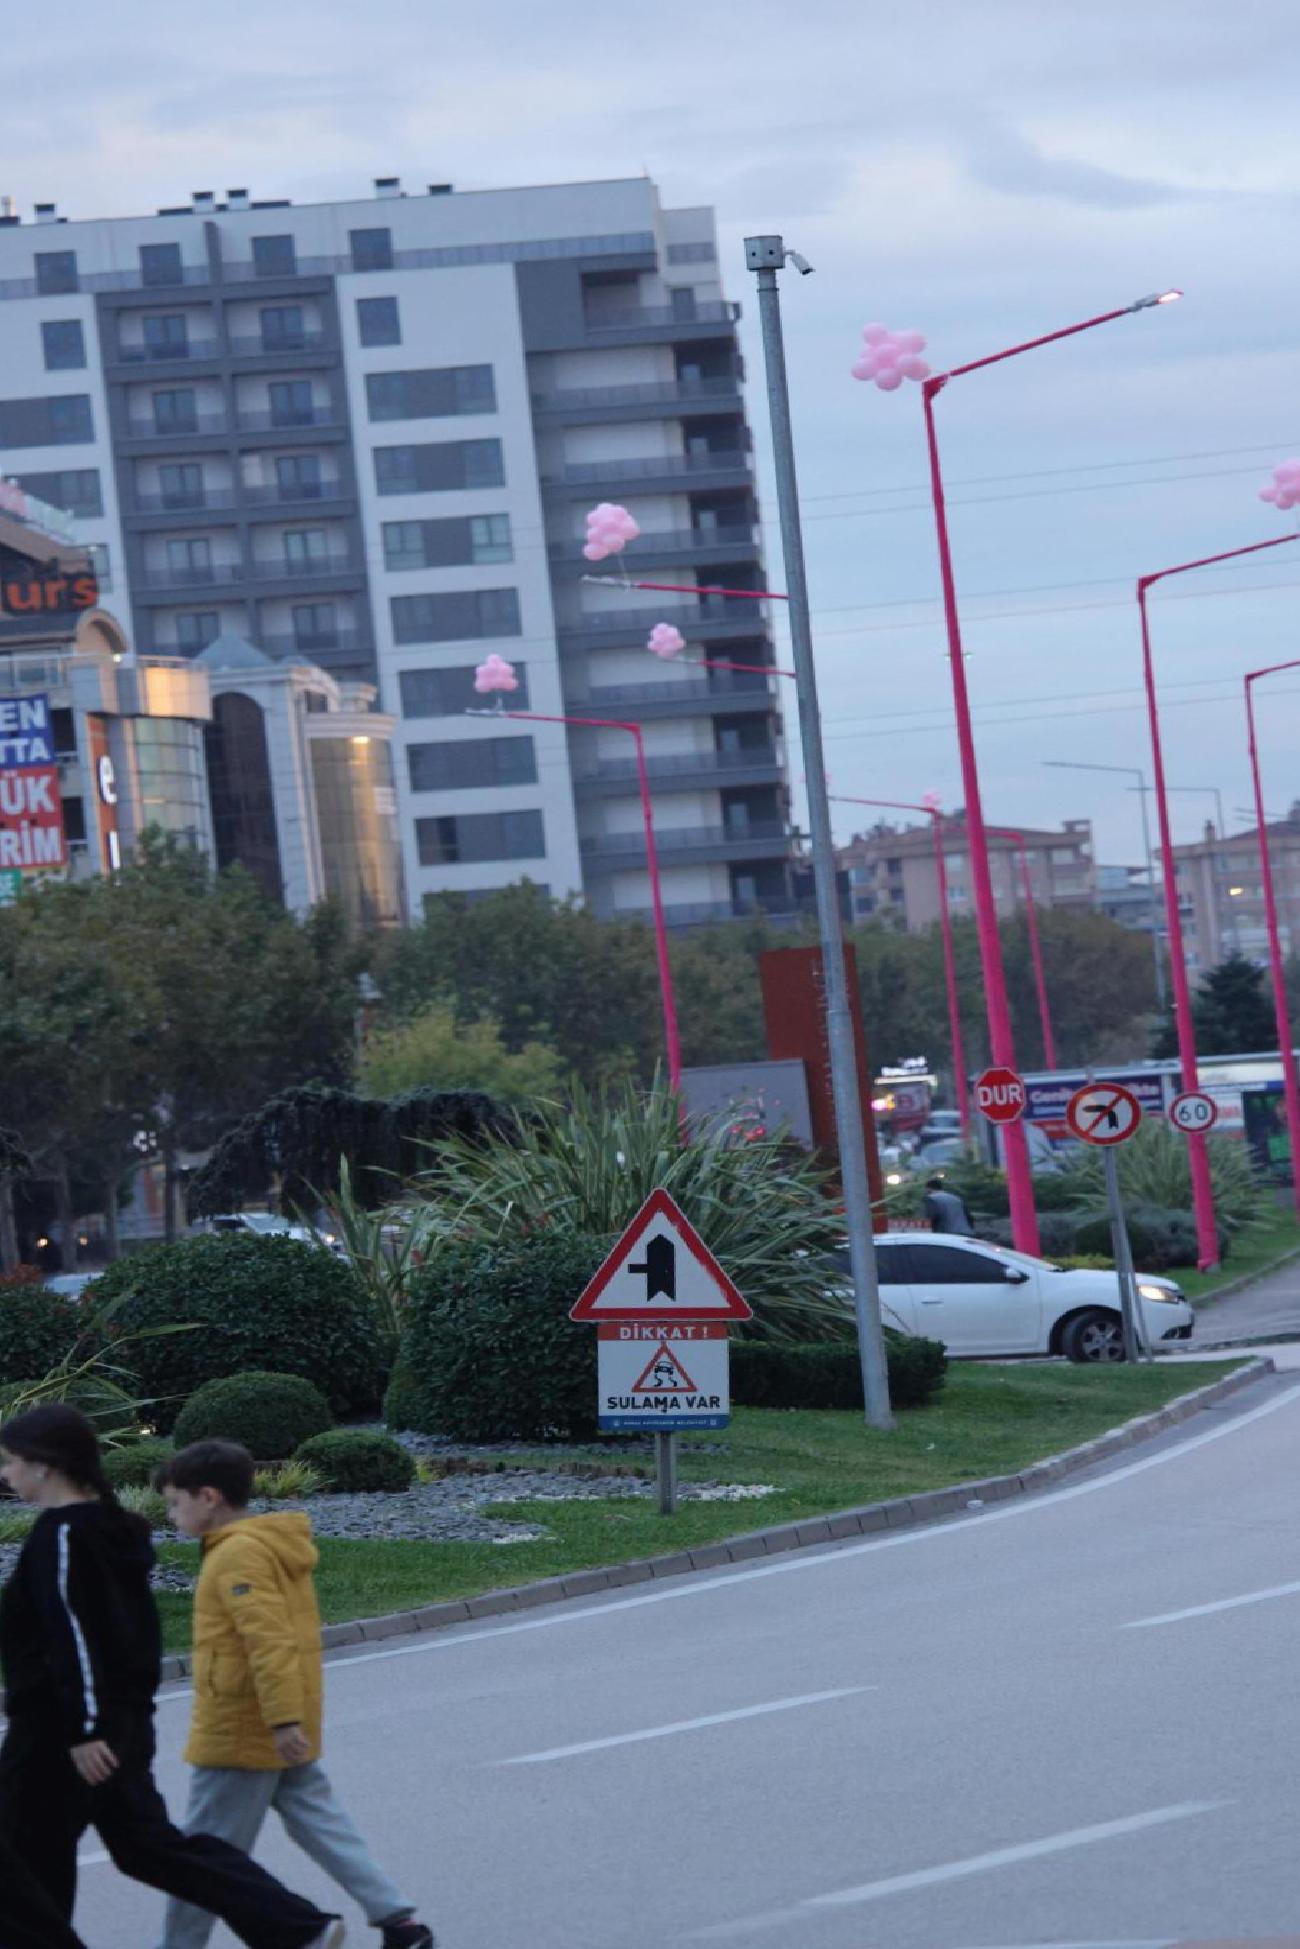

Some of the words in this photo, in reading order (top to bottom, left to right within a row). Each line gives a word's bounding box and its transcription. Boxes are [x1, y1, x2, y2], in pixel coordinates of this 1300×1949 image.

[977, 1084, 1022, 1107] DUR
[1179, 1103, 1208, 1121] 60
[620, 1323, 696, 1340] DİKKAT
[607, 1396, 682, 1411] SULAMA
[686, 1396, 721, 1409] VAR
